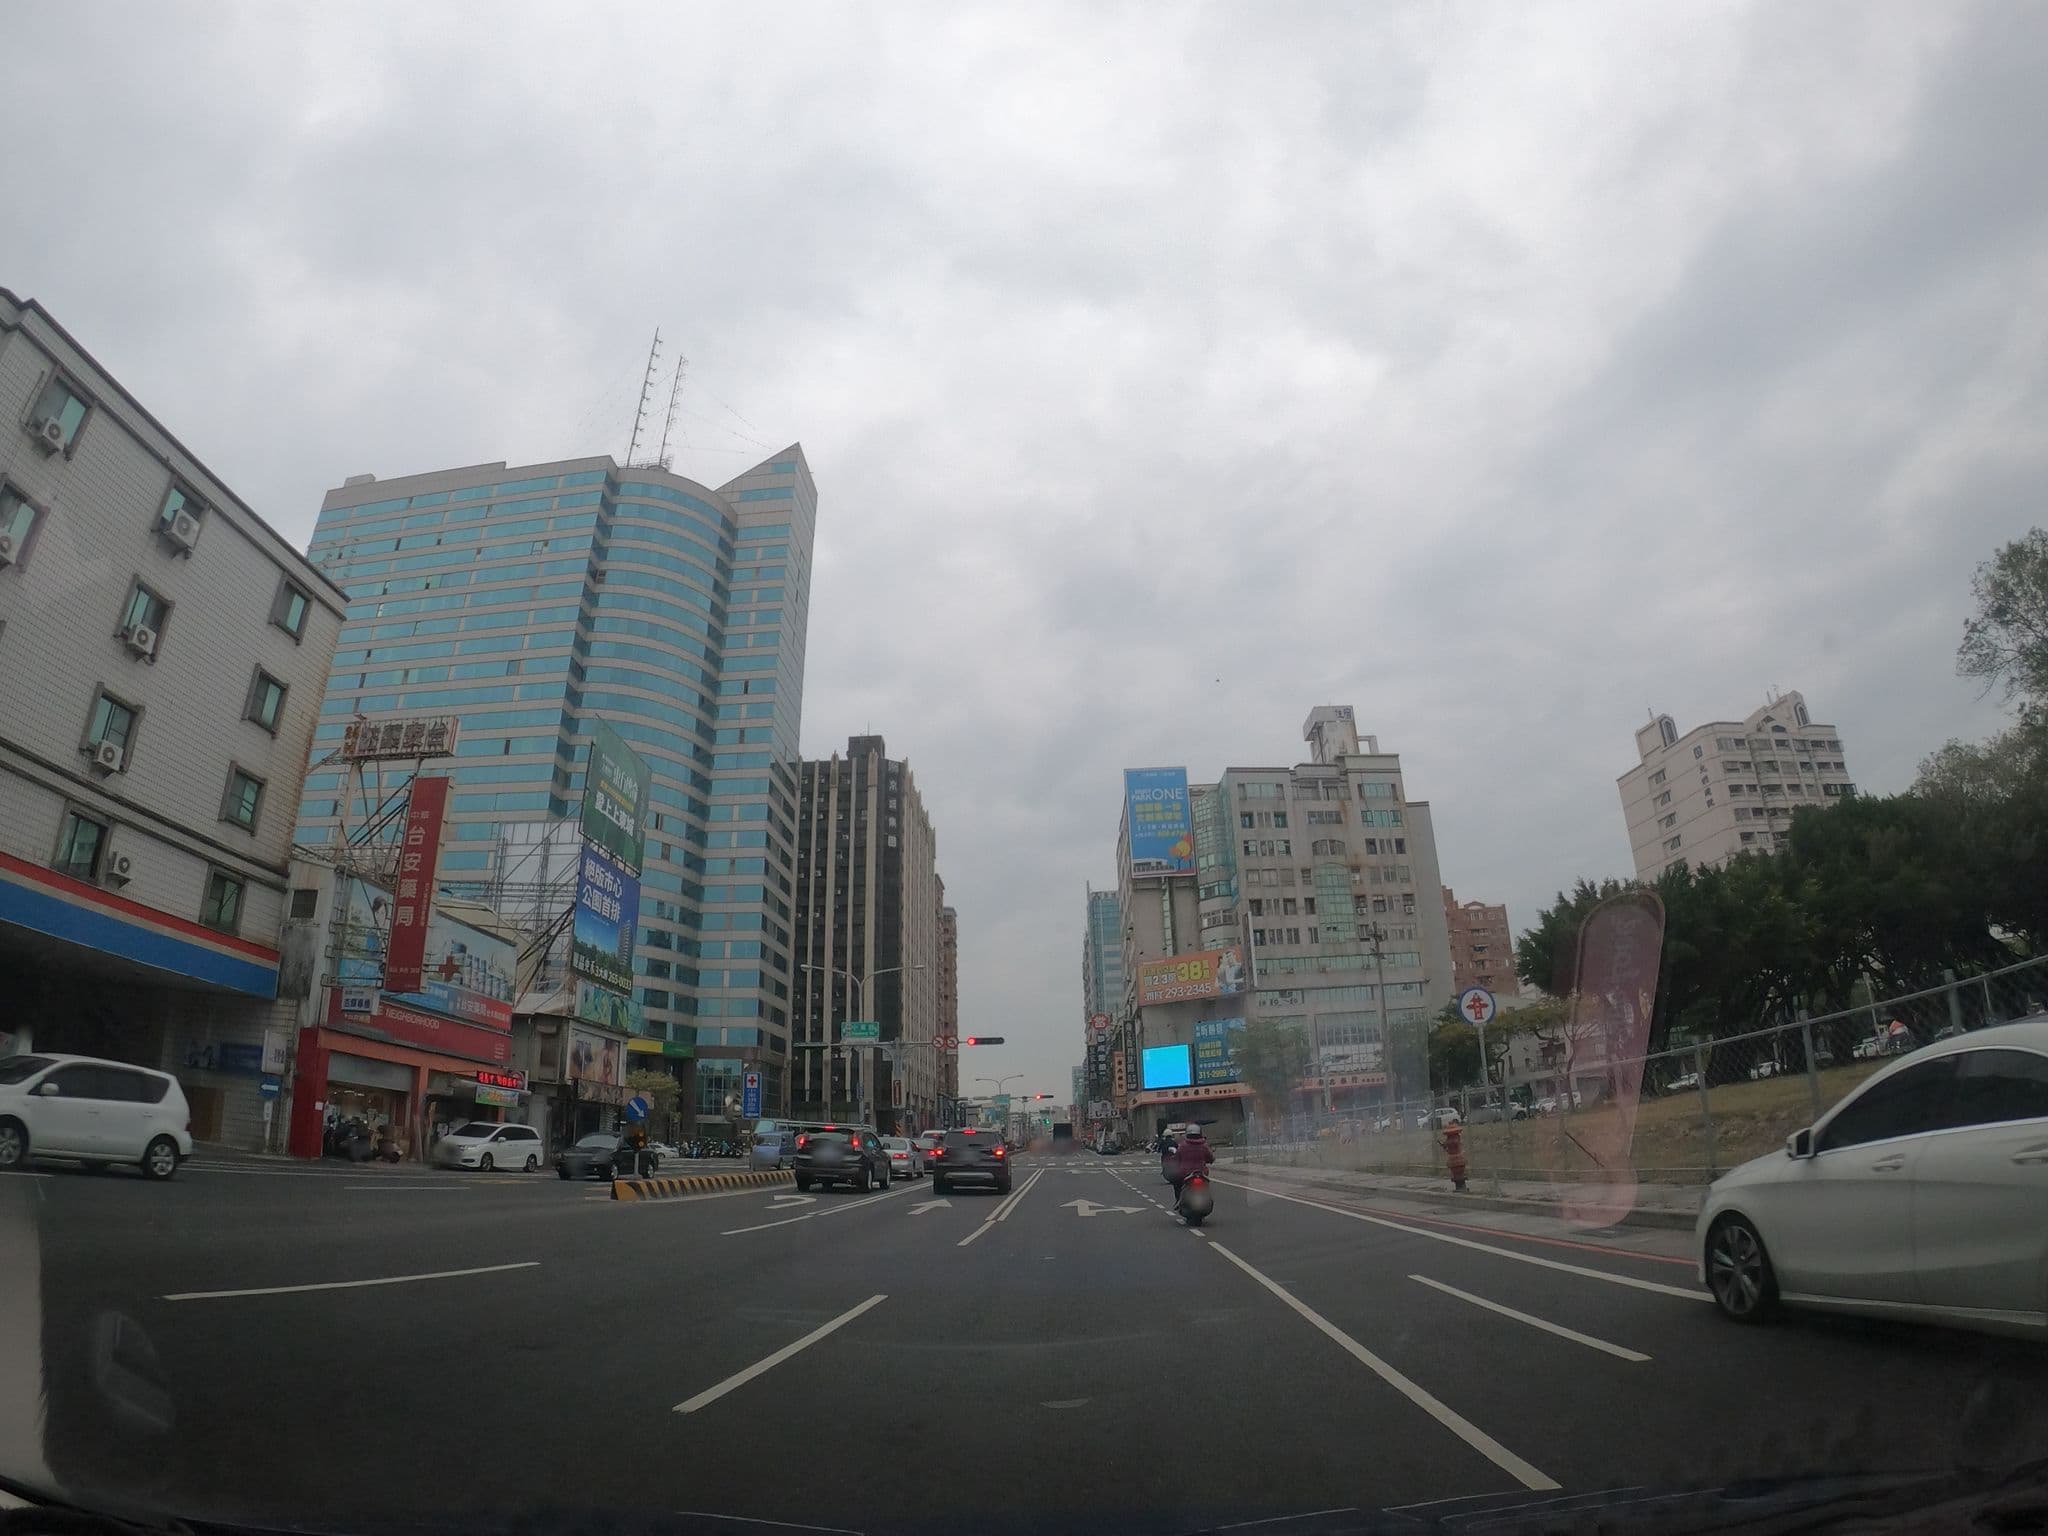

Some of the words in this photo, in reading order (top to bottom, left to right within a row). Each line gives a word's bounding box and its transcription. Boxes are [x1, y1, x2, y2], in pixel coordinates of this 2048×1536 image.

[1152, 788, 1184, 800] ONE
[395, 824, 424, 927] 台安藥局
[585, 857, 624, 899] 絕版市心
[582, 884, 620, 923] 公園首排
